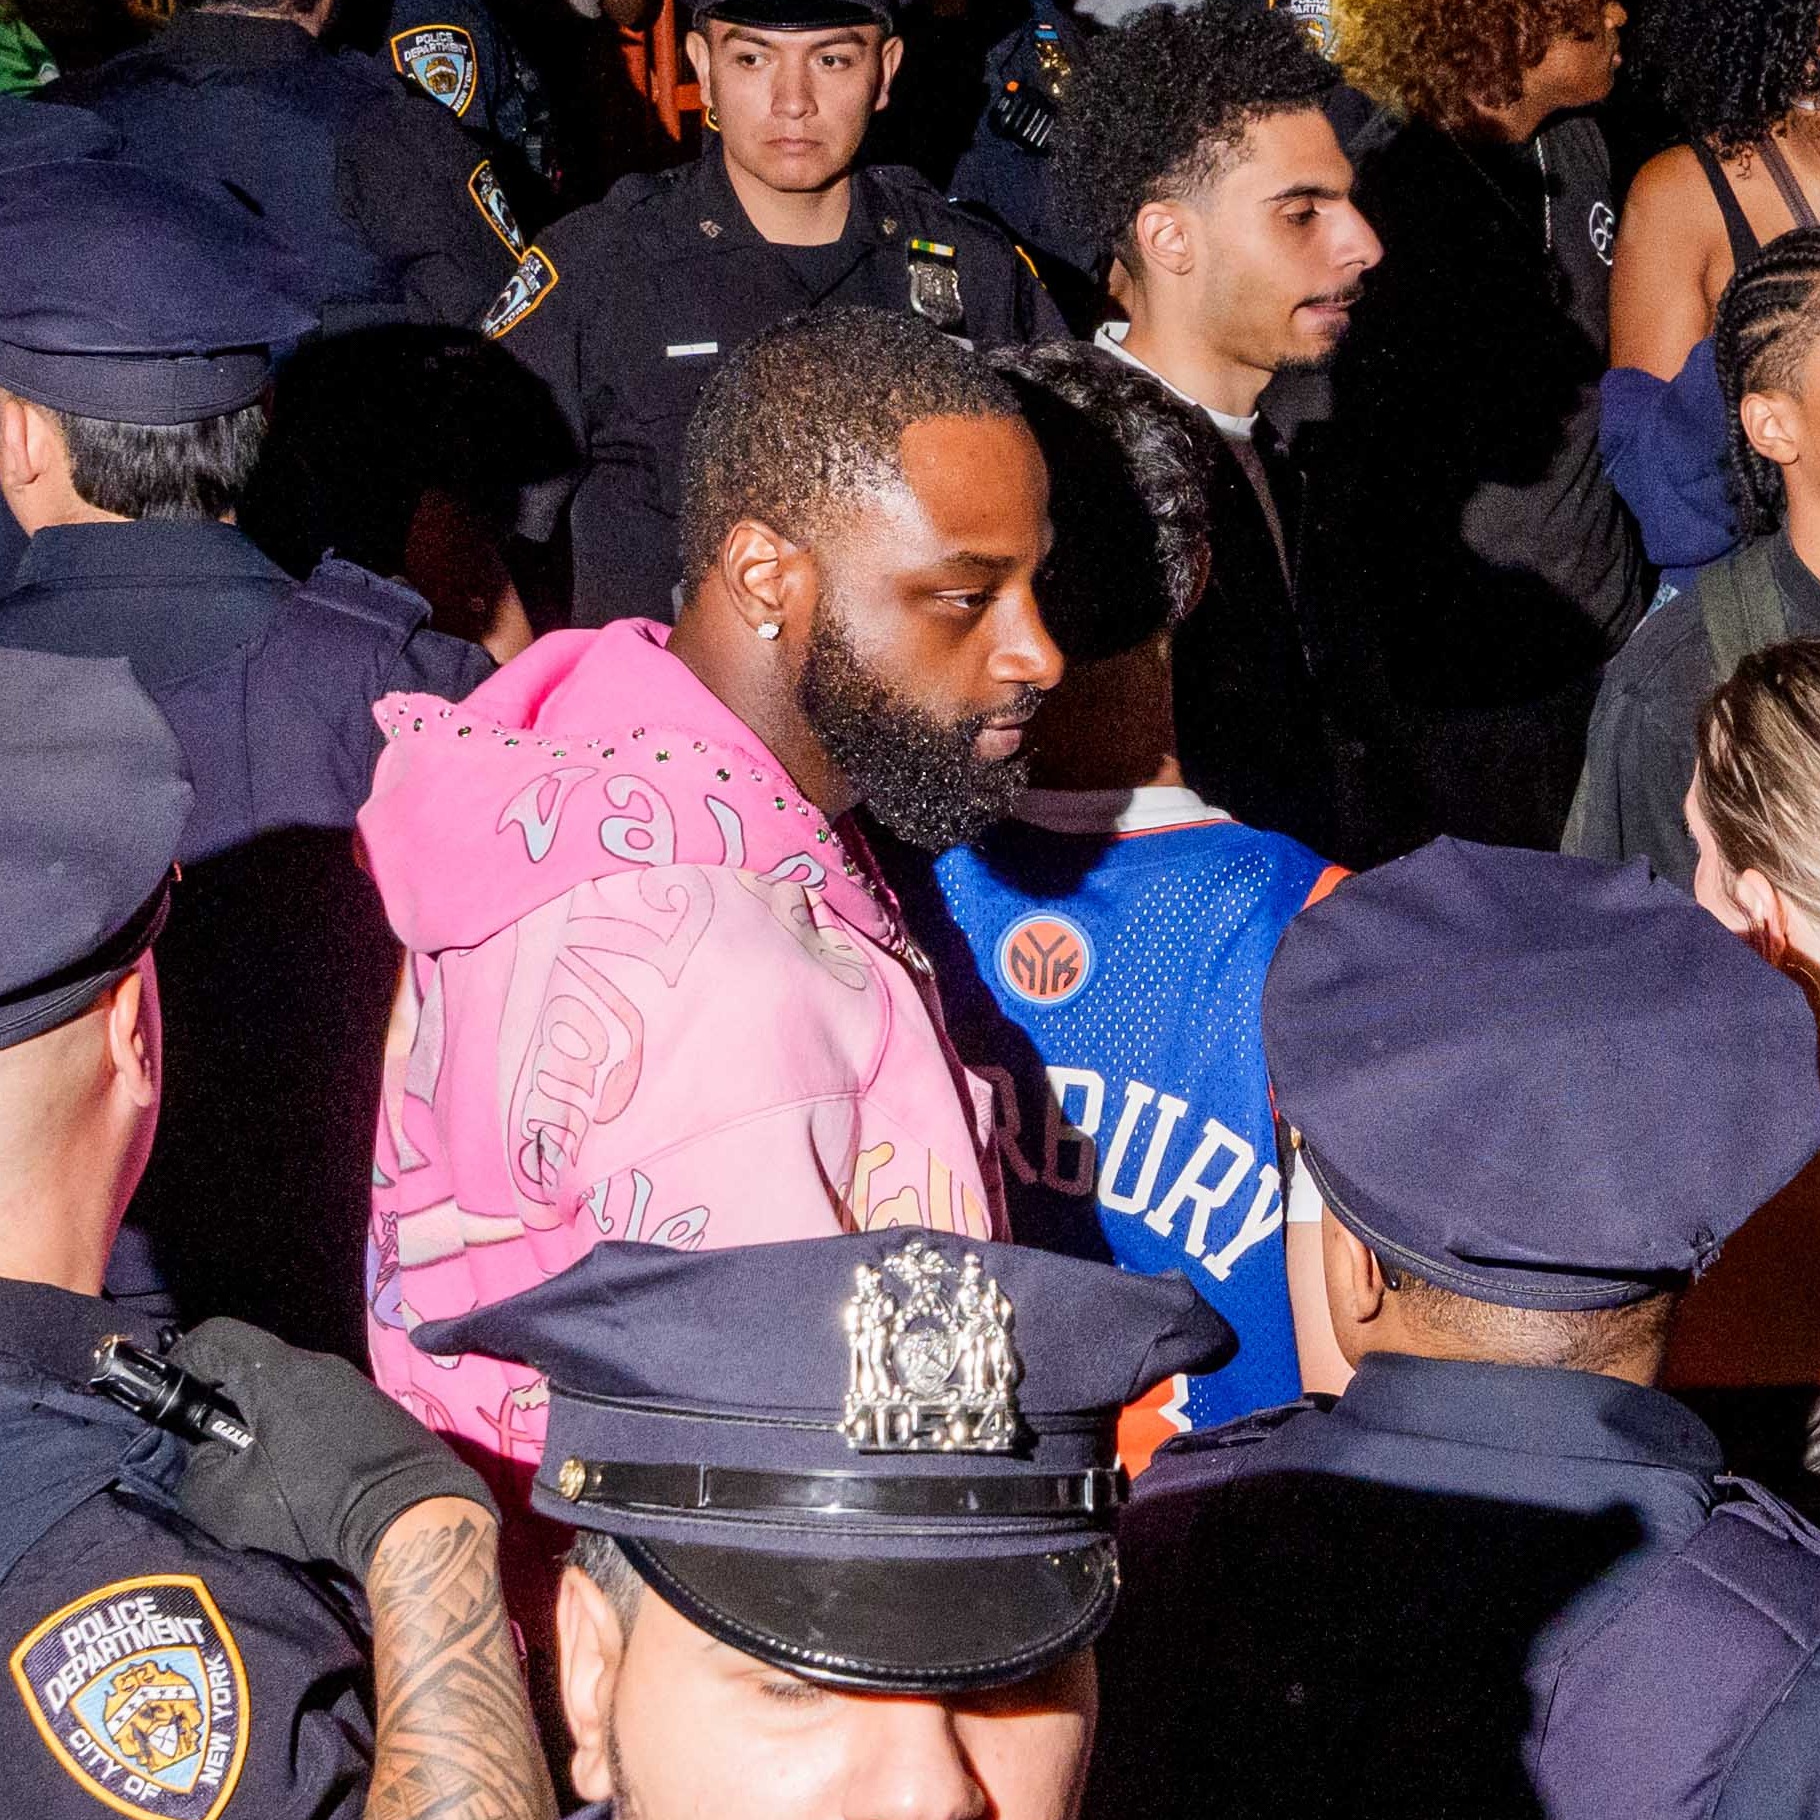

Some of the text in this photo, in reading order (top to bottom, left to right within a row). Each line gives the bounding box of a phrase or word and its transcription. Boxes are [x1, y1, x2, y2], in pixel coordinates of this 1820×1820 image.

[404, 41, 469, 62] DEPARTMENT
[416, 32, 454, 46] POLICE
[1010, 928, 1080, 995] NYK
[61, 1594, 163, 1656] POLICE
[44, 1616, 206, 1715] DEPARTMENT
[199, 1652, 234, 1785] NEW YORK
[69, 1728, 163, 1801] CITY OF
